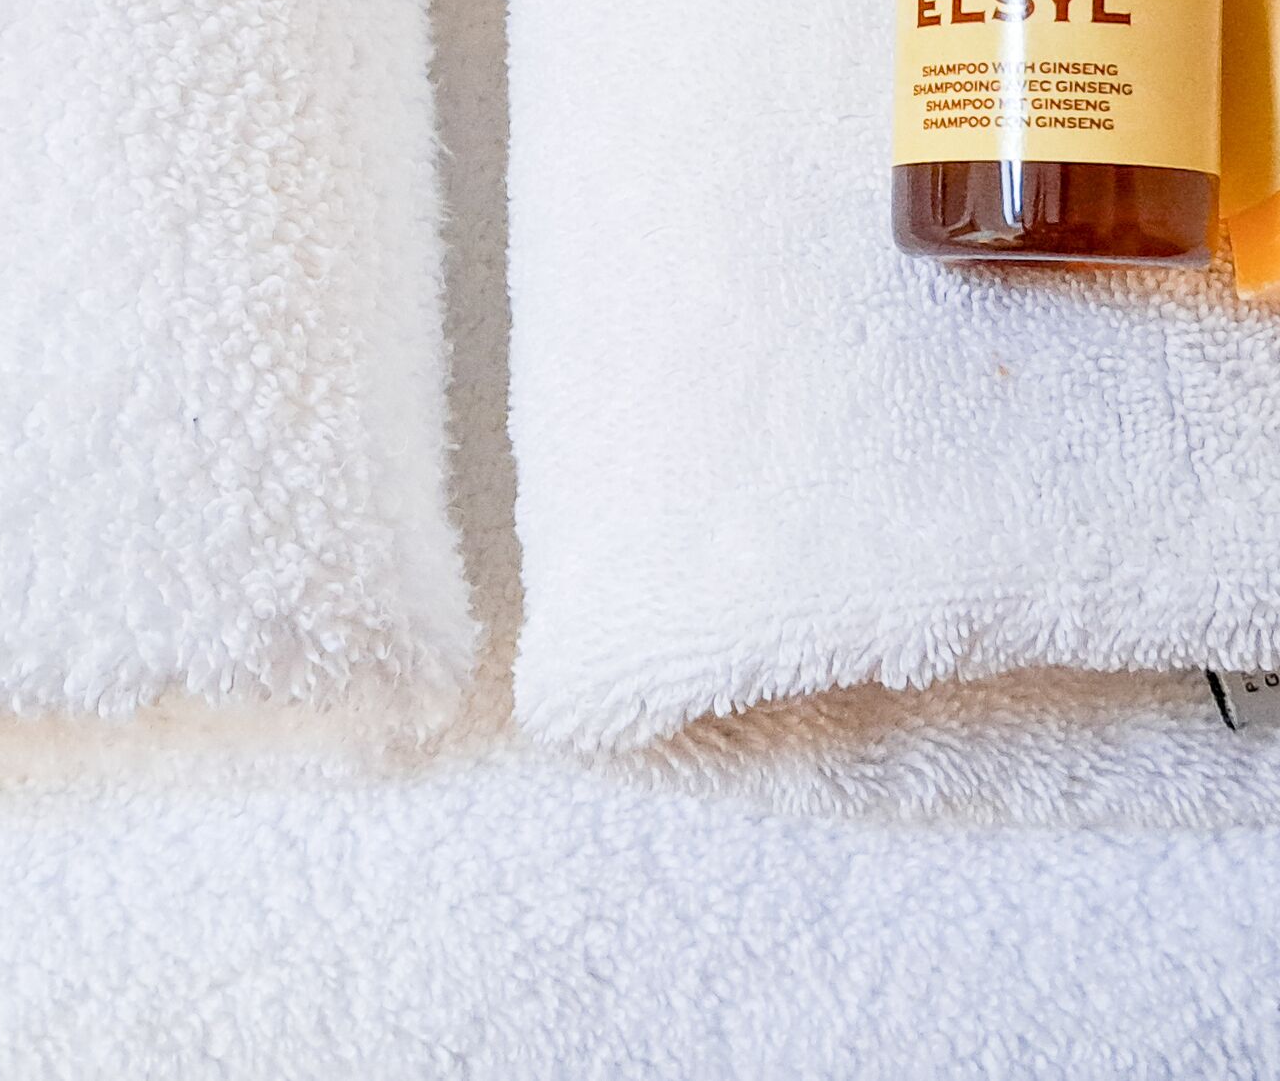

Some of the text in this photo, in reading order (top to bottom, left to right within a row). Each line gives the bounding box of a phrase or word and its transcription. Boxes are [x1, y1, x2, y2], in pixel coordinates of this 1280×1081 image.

[922, 62, 1118, 77] SHAMPOO WTH GINSENG
[913, 80, 1133, 96] SHAMPOOING VEC GINSENG
[926, 98, 995, 112] SHAMPOO
[1031, 98, 1111, 112] GINSENG
[923, 116, 1115, 130] SHAMPOO CN GINSENG
